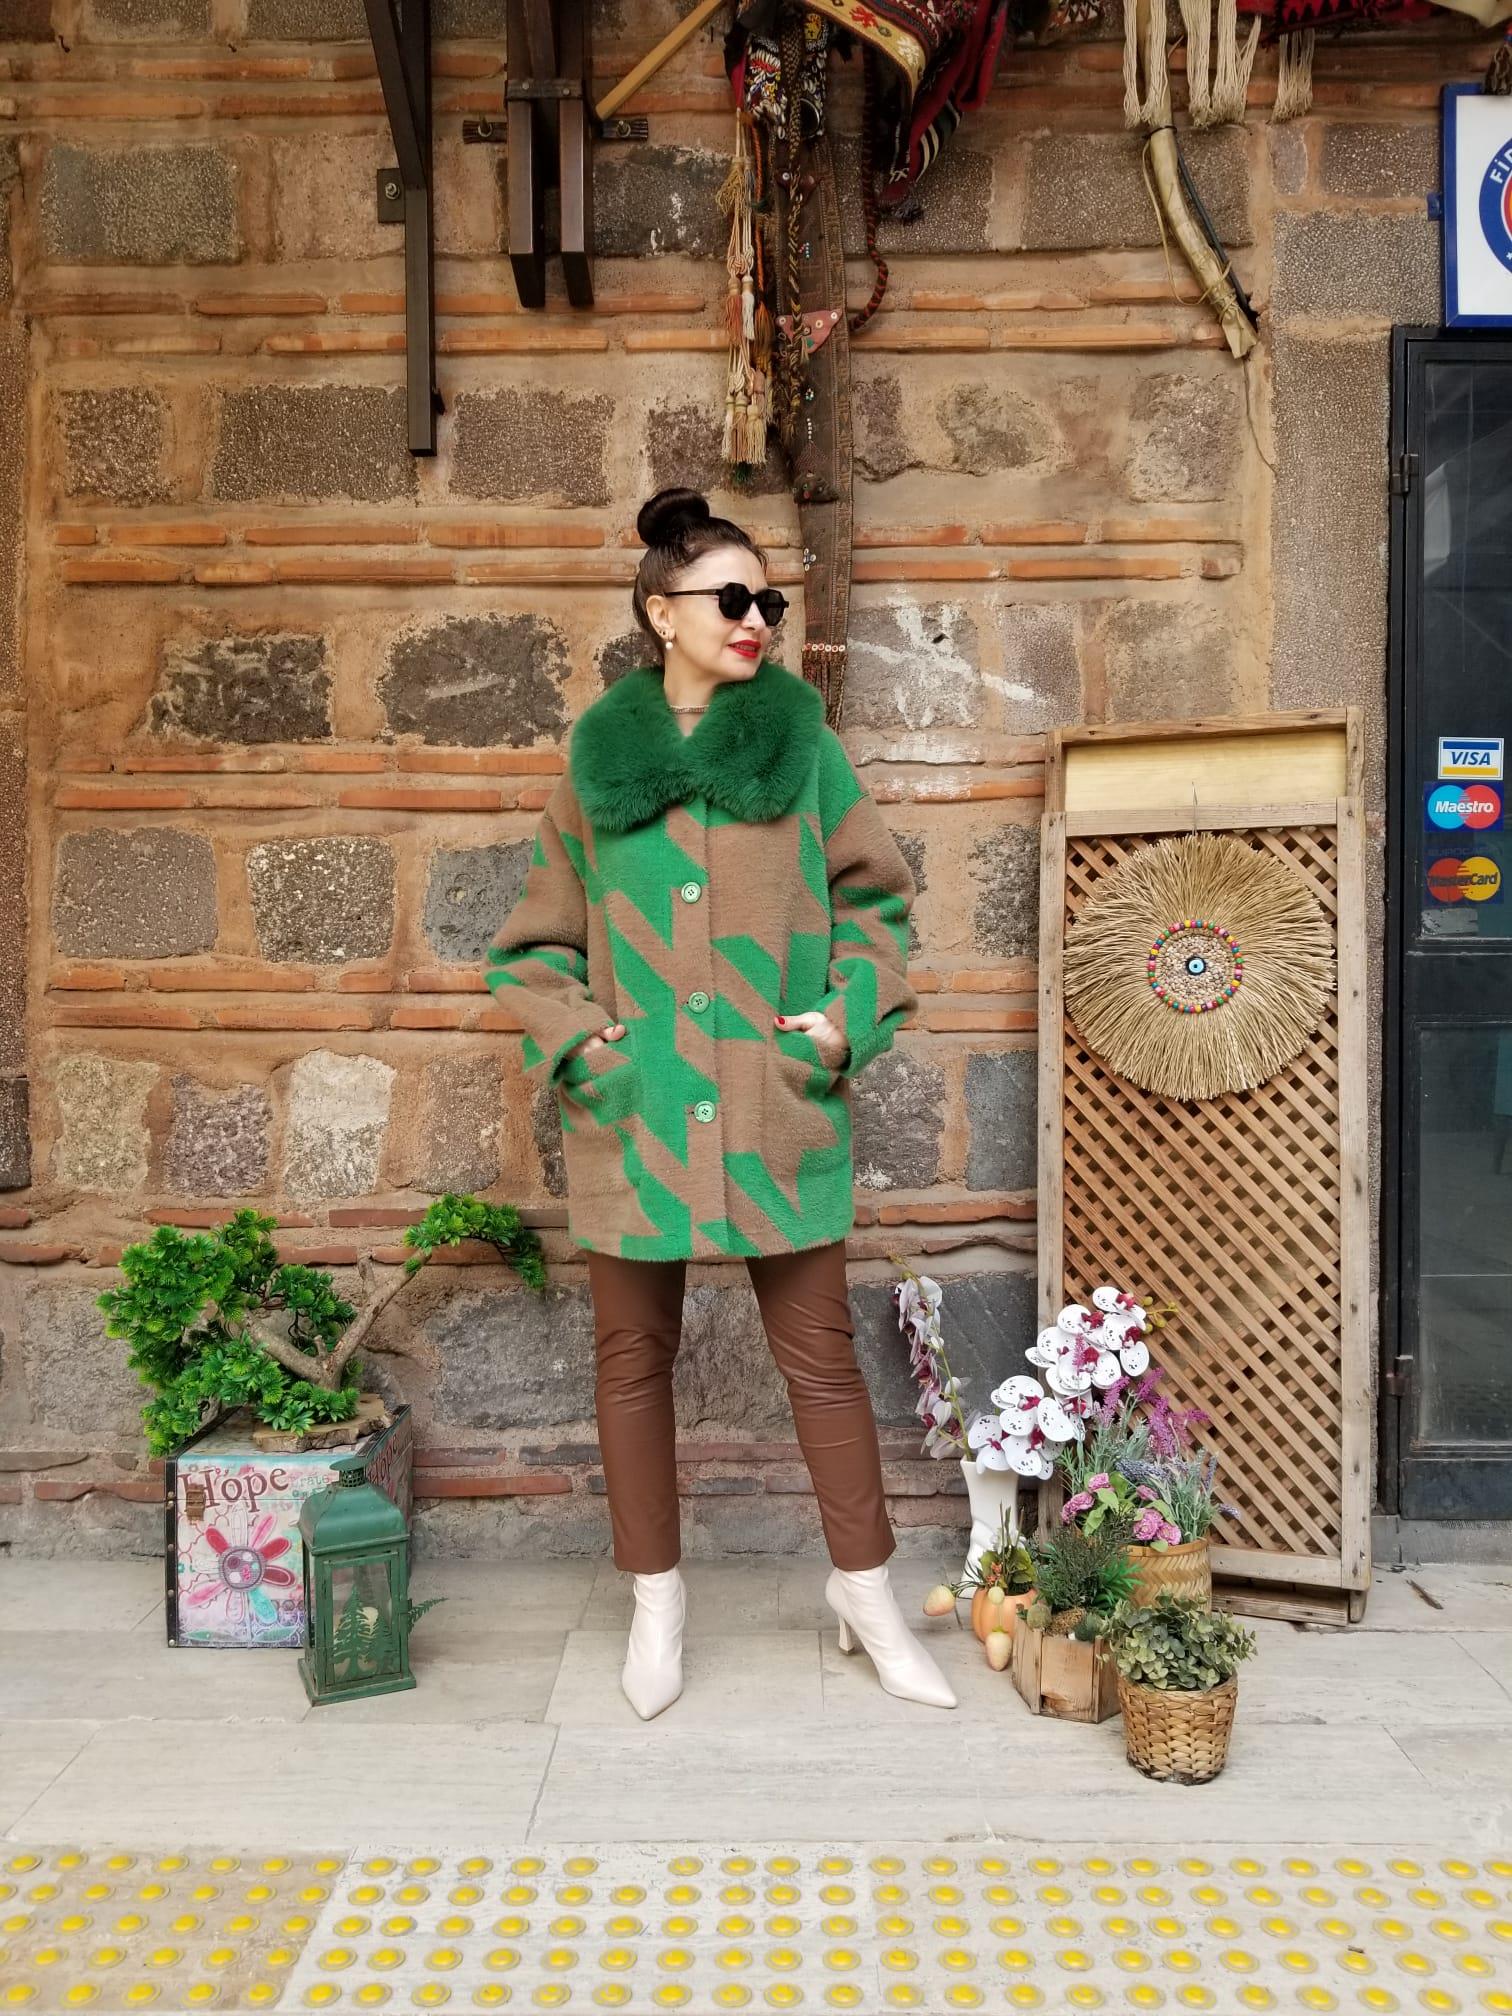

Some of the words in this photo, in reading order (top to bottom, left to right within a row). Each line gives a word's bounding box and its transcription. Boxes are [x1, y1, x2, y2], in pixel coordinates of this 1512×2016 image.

[1450, 751, 1491, 766] VISA
[1434, 800, 1495, 813] Maestro
[177, 1468, 289, 1513] Hope
